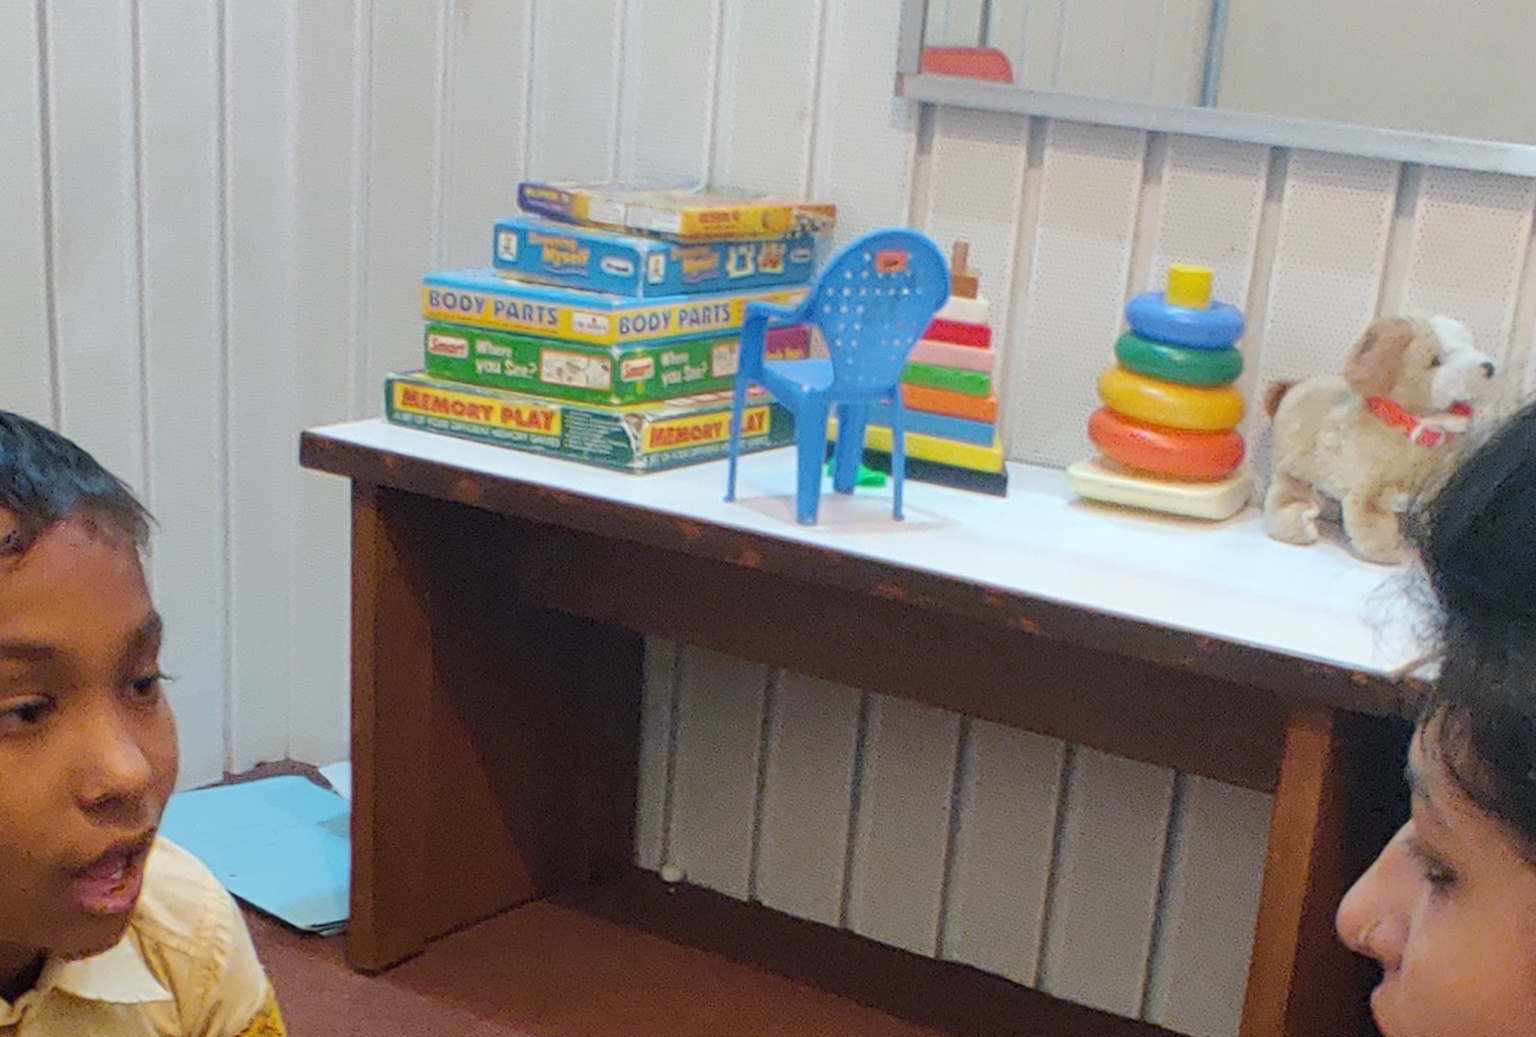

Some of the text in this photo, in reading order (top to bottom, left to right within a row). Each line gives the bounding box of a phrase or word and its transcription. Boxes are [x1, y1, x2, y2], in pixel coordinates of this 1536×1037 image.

[428, 290, 486, 314] BODY
[494, 300, 559, 325] PARTS
[619, 312, 671, 335] BODY
[678, 303, 731, 328] PARTS
[430, 338, 467, 355] Smart
[475, 340, 512, 358] Where
[475, 358, 537, 378] you See?
[401, 387, 494, 421] MEMORY
[500, 407, 557, 431] PLAY
[650, 422, 722, 447] MEMORY
